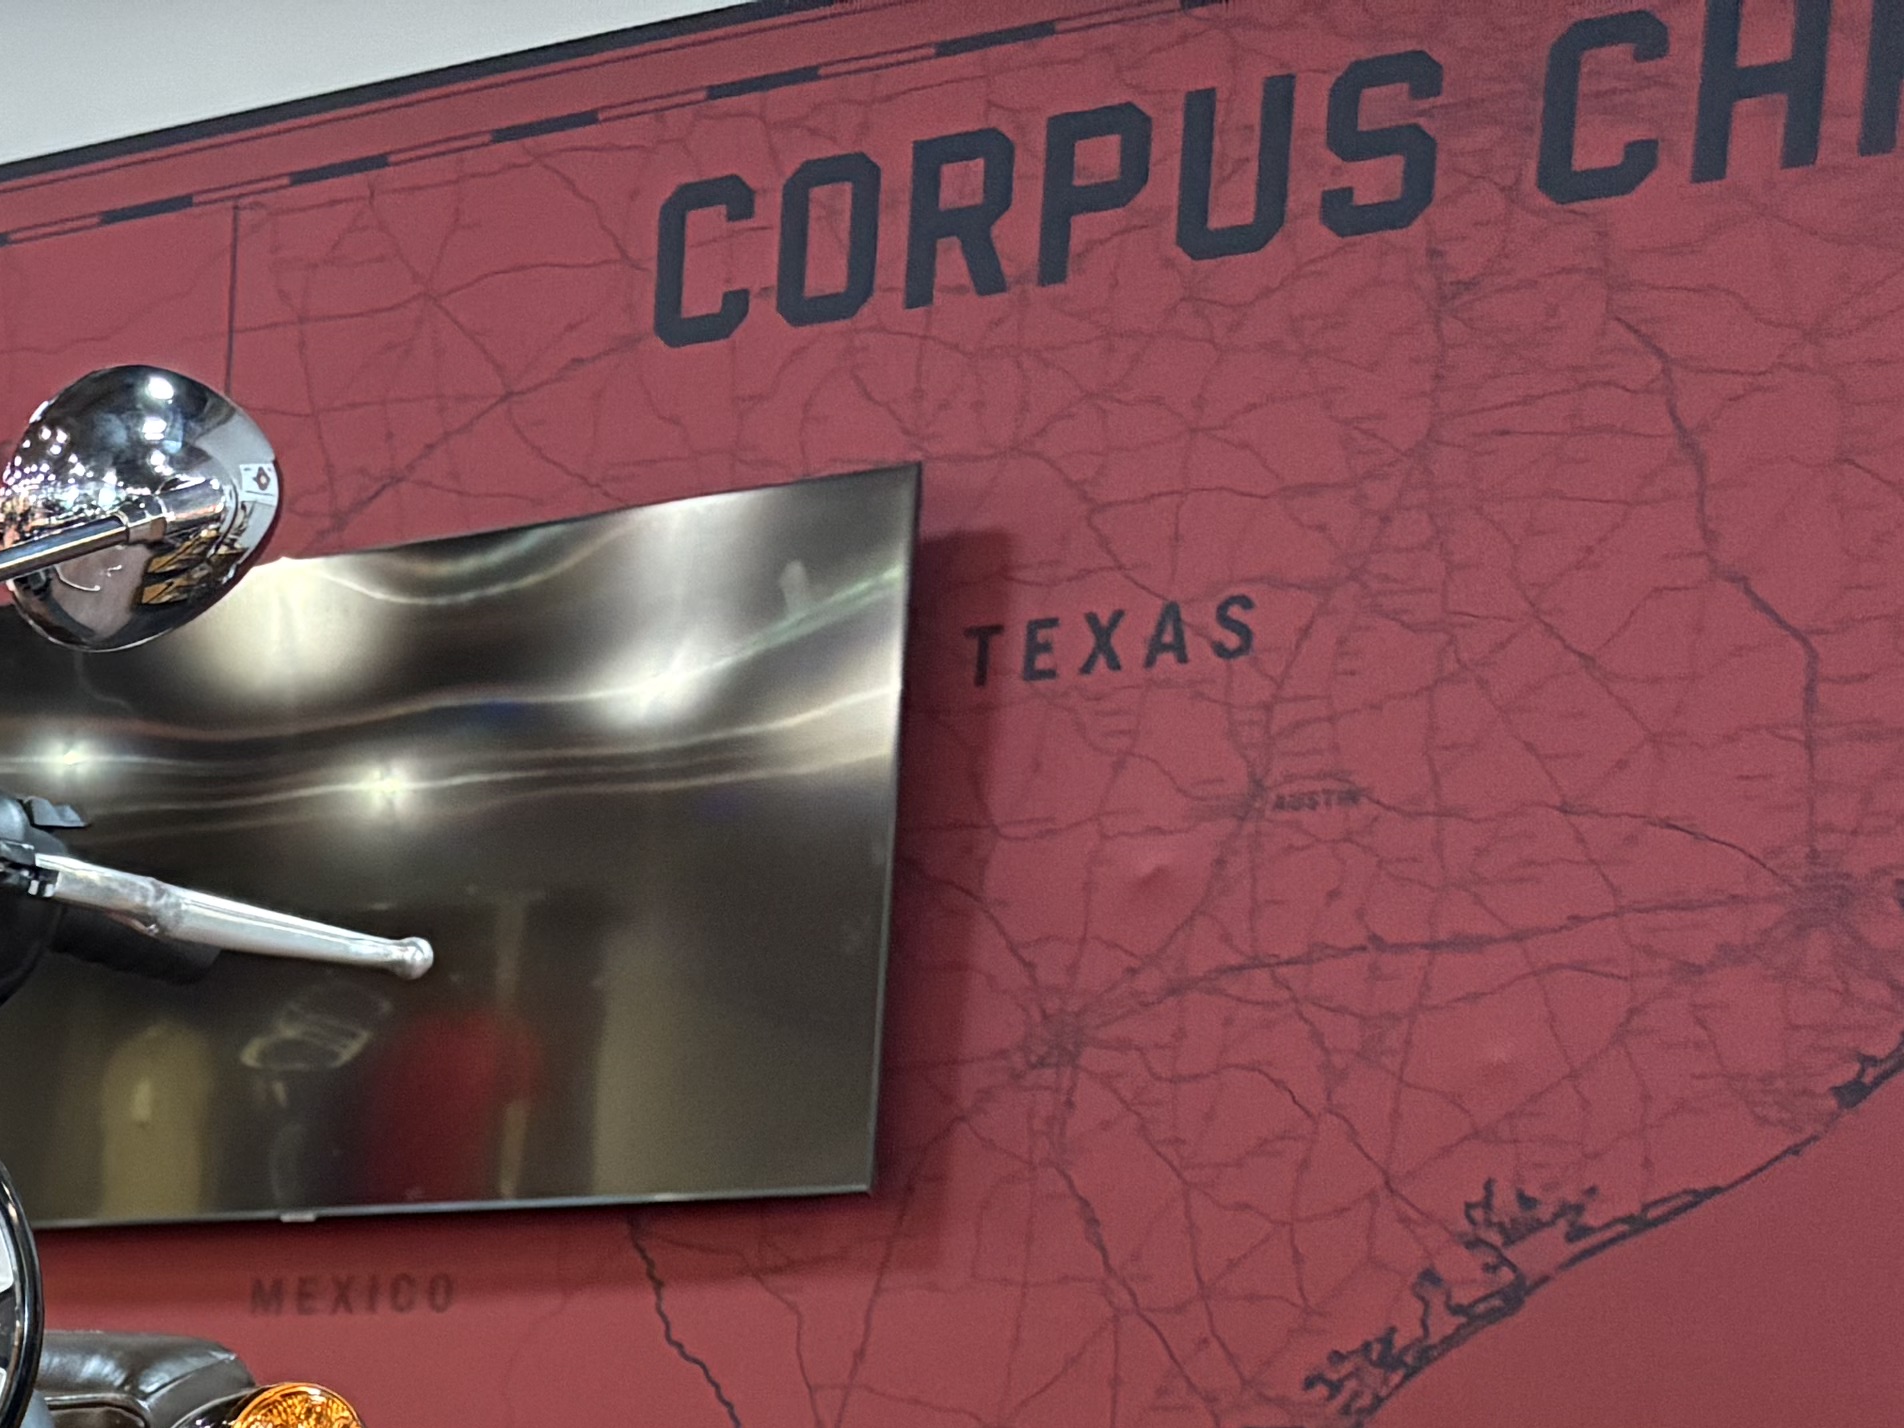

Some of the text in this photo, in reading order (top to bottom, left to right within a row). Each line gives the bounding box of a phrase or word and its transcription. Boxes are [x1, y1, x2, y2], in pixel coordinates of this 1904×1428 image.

[653, 49, 1445, 349] CORPUS
[964, 594, 1258, 689] TEXAS
[250, 1272, 457, 1317] MEXICO
